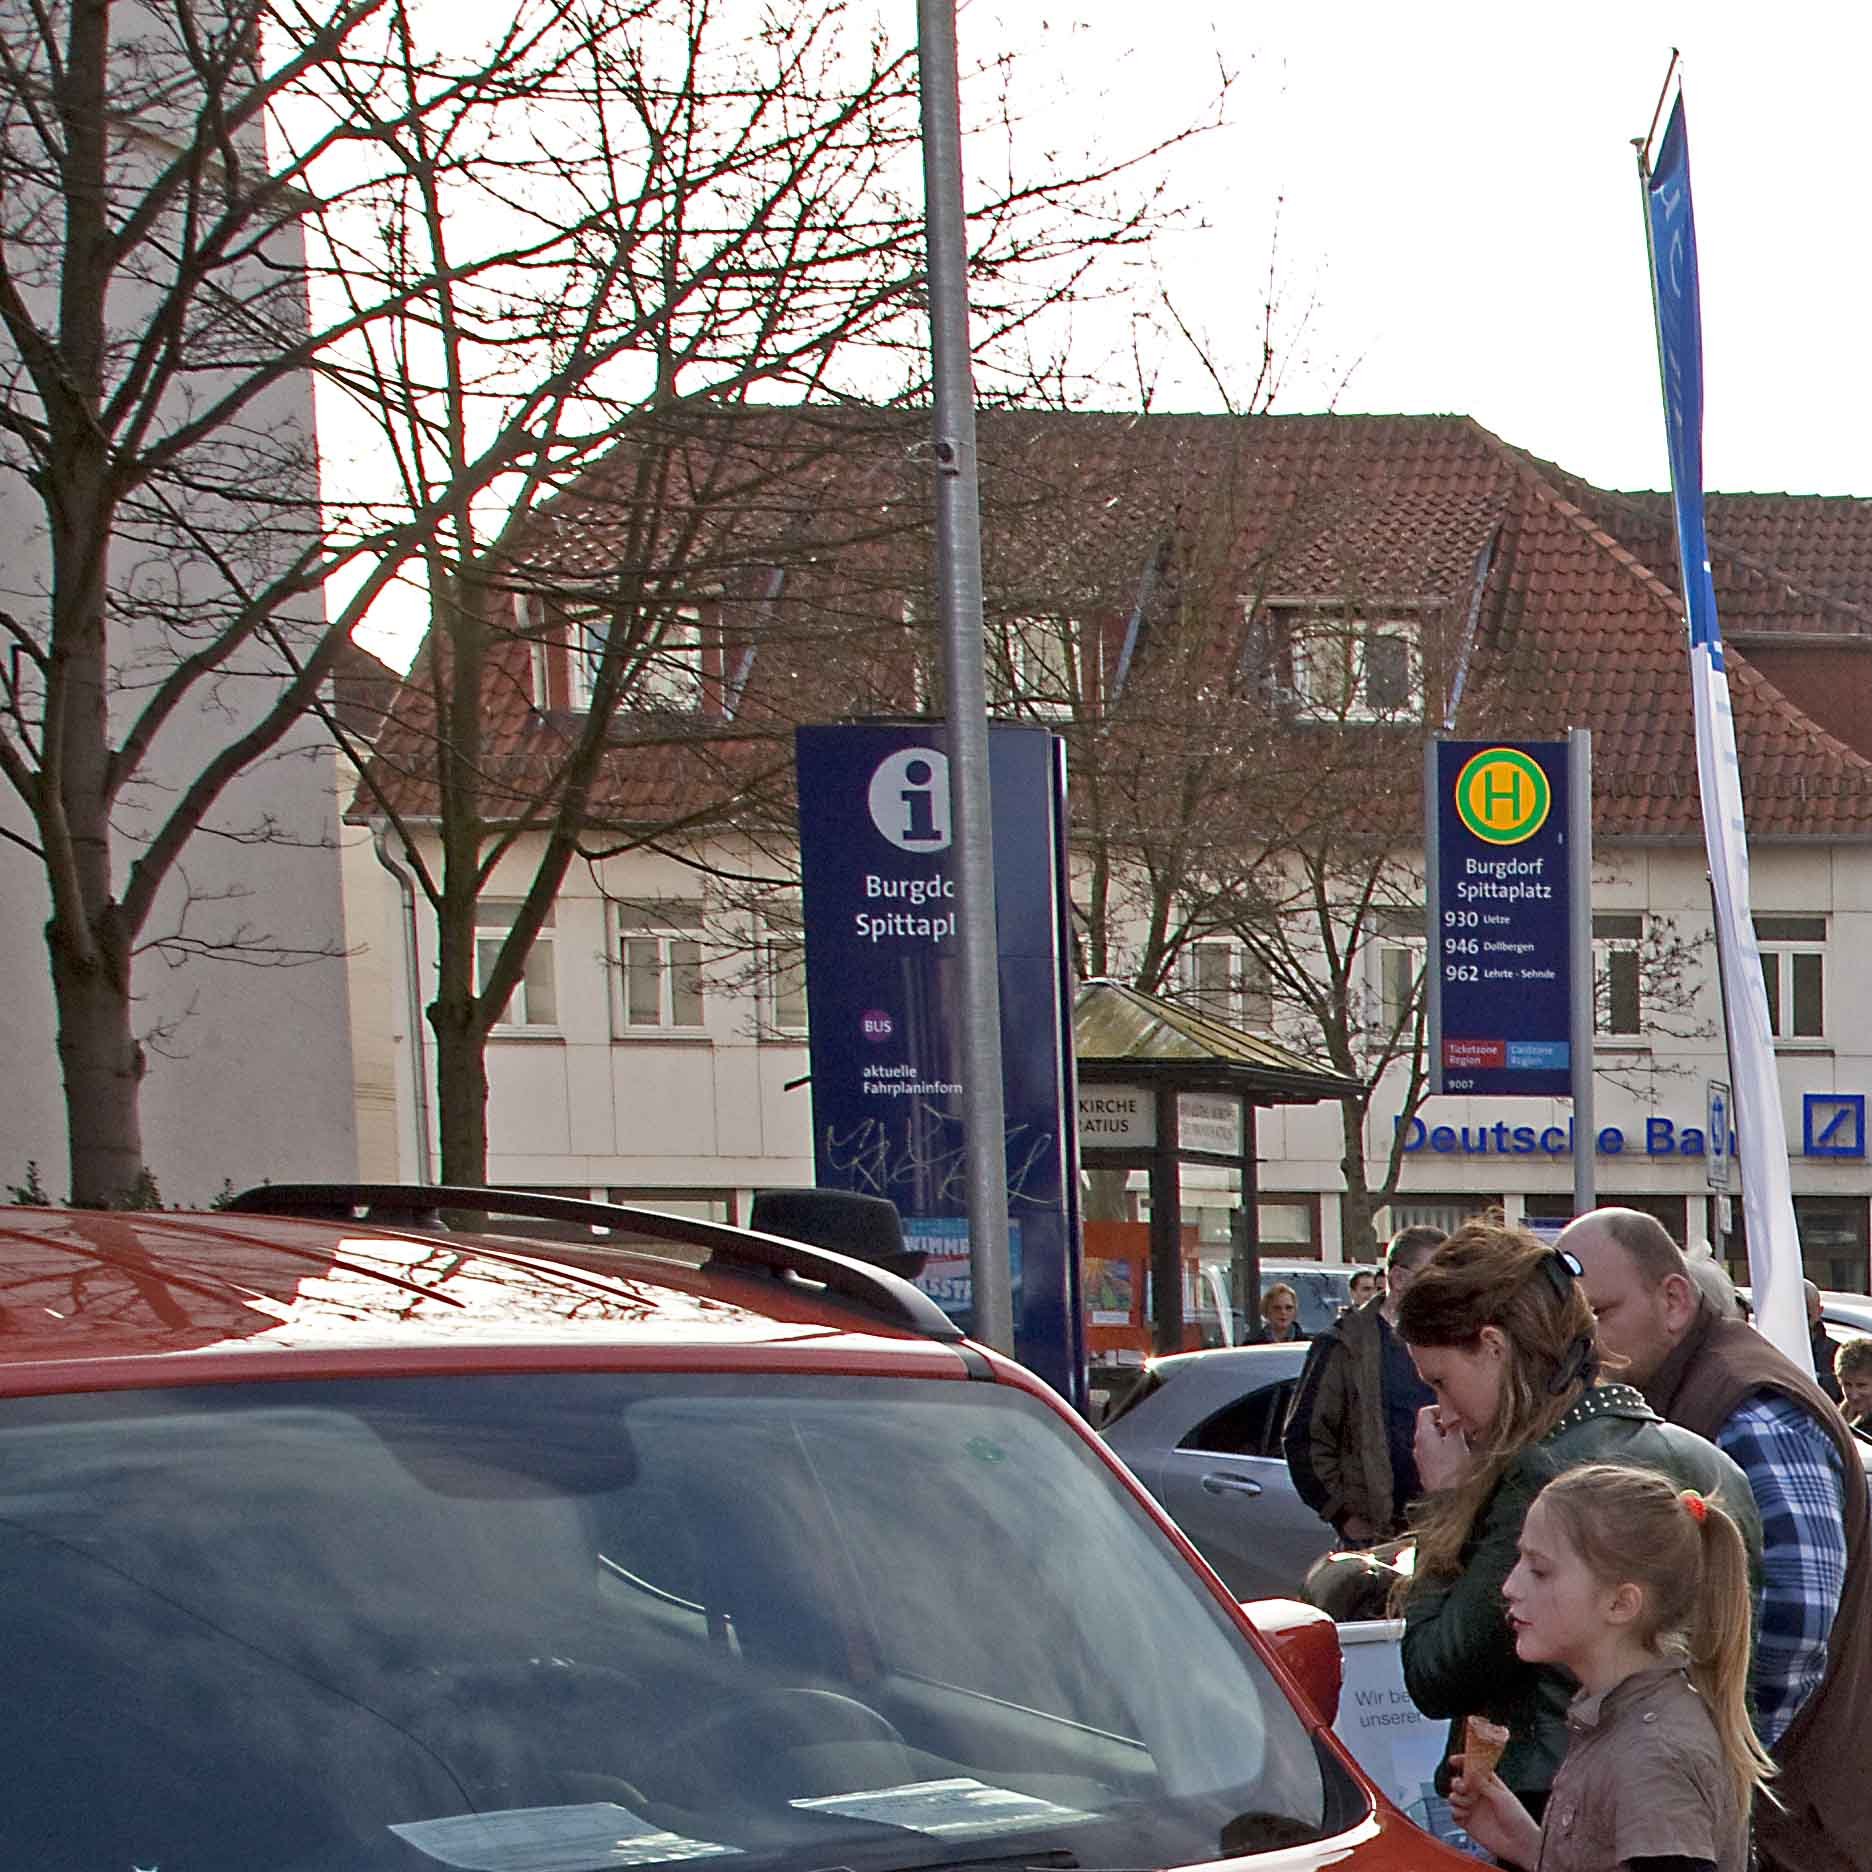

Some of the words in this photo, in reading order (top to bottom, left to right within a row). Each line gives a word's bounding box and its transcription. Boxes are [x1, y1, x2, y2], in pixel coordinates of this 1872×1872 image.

[1466, 858, 1544, 880] Burgdorf
[866, 874, 954, 905] Burgdo
[1457, 881, 1552, 903] Spittaplatz
[856, 912, 956, 943] Spittapl
[1444, 911, 1479, 928] 930
[1445, 938, 1479, 954] 946
[1446, 965, 1480, 981] 962
[1484, 968, 1513, 979] Lehrte
[864, 1019, 893, 1033] BUS
[863, 1065, 918, 1079] aktuelle
[1079, 1099, 1137, 1114] KIRCHE
[1355, 1689, 1386, 1707] Wir
[1390, 1686, 1411, 1704] be
